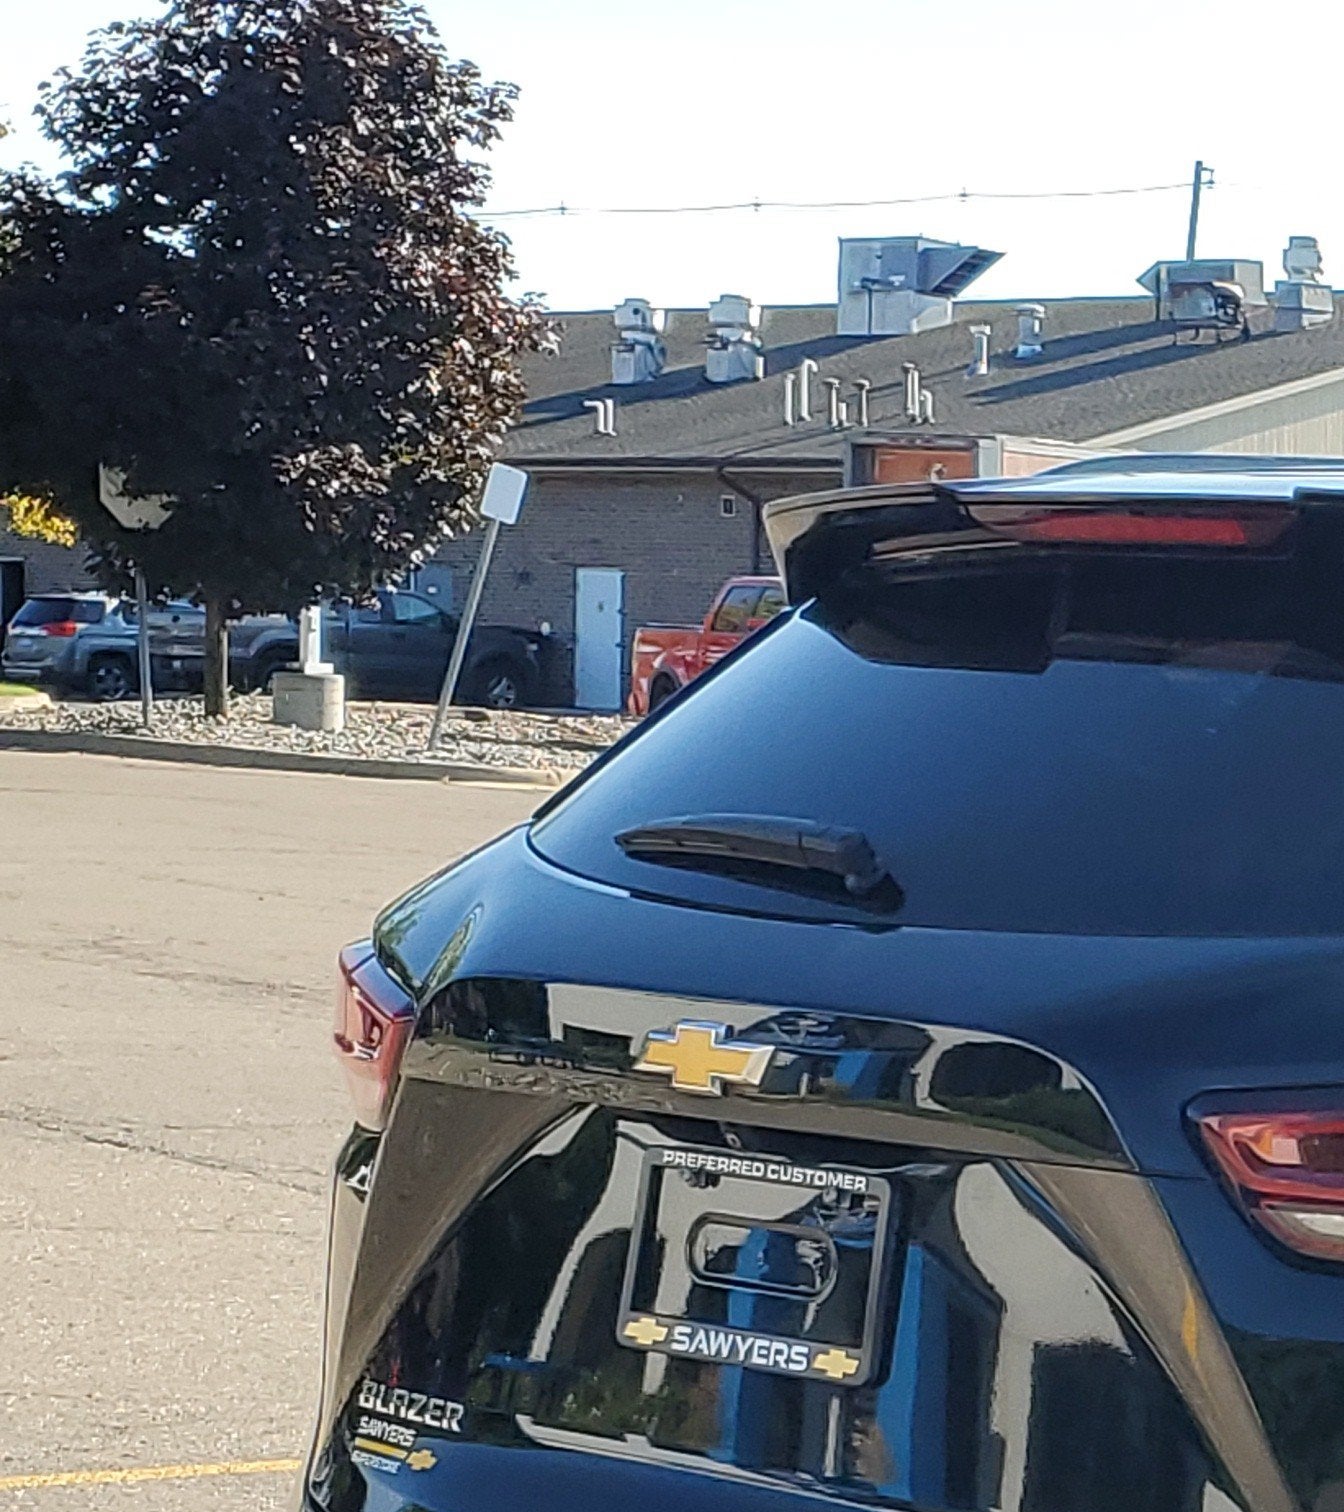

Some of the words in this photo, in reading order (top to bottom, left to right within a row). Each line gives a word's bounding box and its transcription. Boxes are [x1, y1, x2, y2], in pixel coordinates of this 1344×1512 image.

[663, 1150, 763, 1178] PREFERRED
[767, 1160, 867, 1192] CUSTOMER
[671, 1325, 809, 1371] SAWYERS
[358, 1378, 464, 1433] BLAZER
[356, 1415, 418, 1448] SAWYERS
